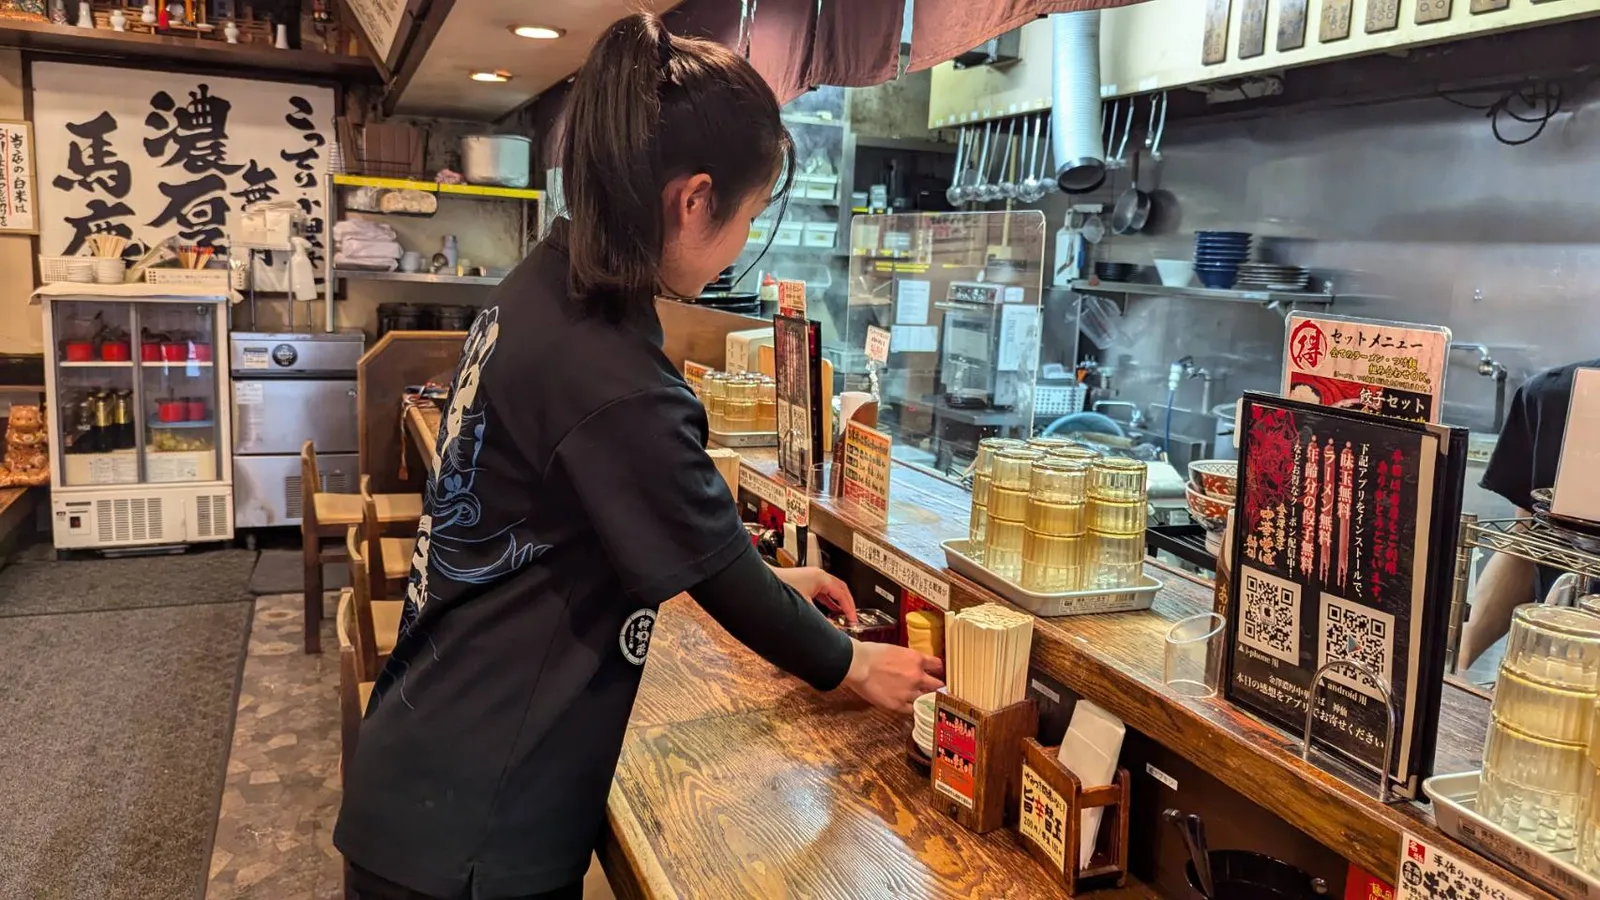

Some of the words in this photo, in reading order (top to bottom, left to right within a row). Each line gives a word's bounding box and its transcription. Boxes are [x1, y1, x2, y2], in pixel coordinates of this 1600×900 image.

[10, 133, 28, 213] 当店の白米は
[1331, 328, 1423, 349] セットメニュー
[1360, 387, 1425, 413] 餃子セット
[1300, 444, 1320, 575] 年齢分の餃子無料
[1318, 450, 1336, 547] ラーメン無料
[1338, 451, 1355, 519] 味玉無料
[1271, 657, 1279, 669] 用
[1236, 672, 1385, 748] 本日の感想をアプリでお寄せください
[1327, 683, 1358, 703] android
[1359, 695, 1368, 707] 用
[1433, 853, 1512, 900] 手作りの味をどう
